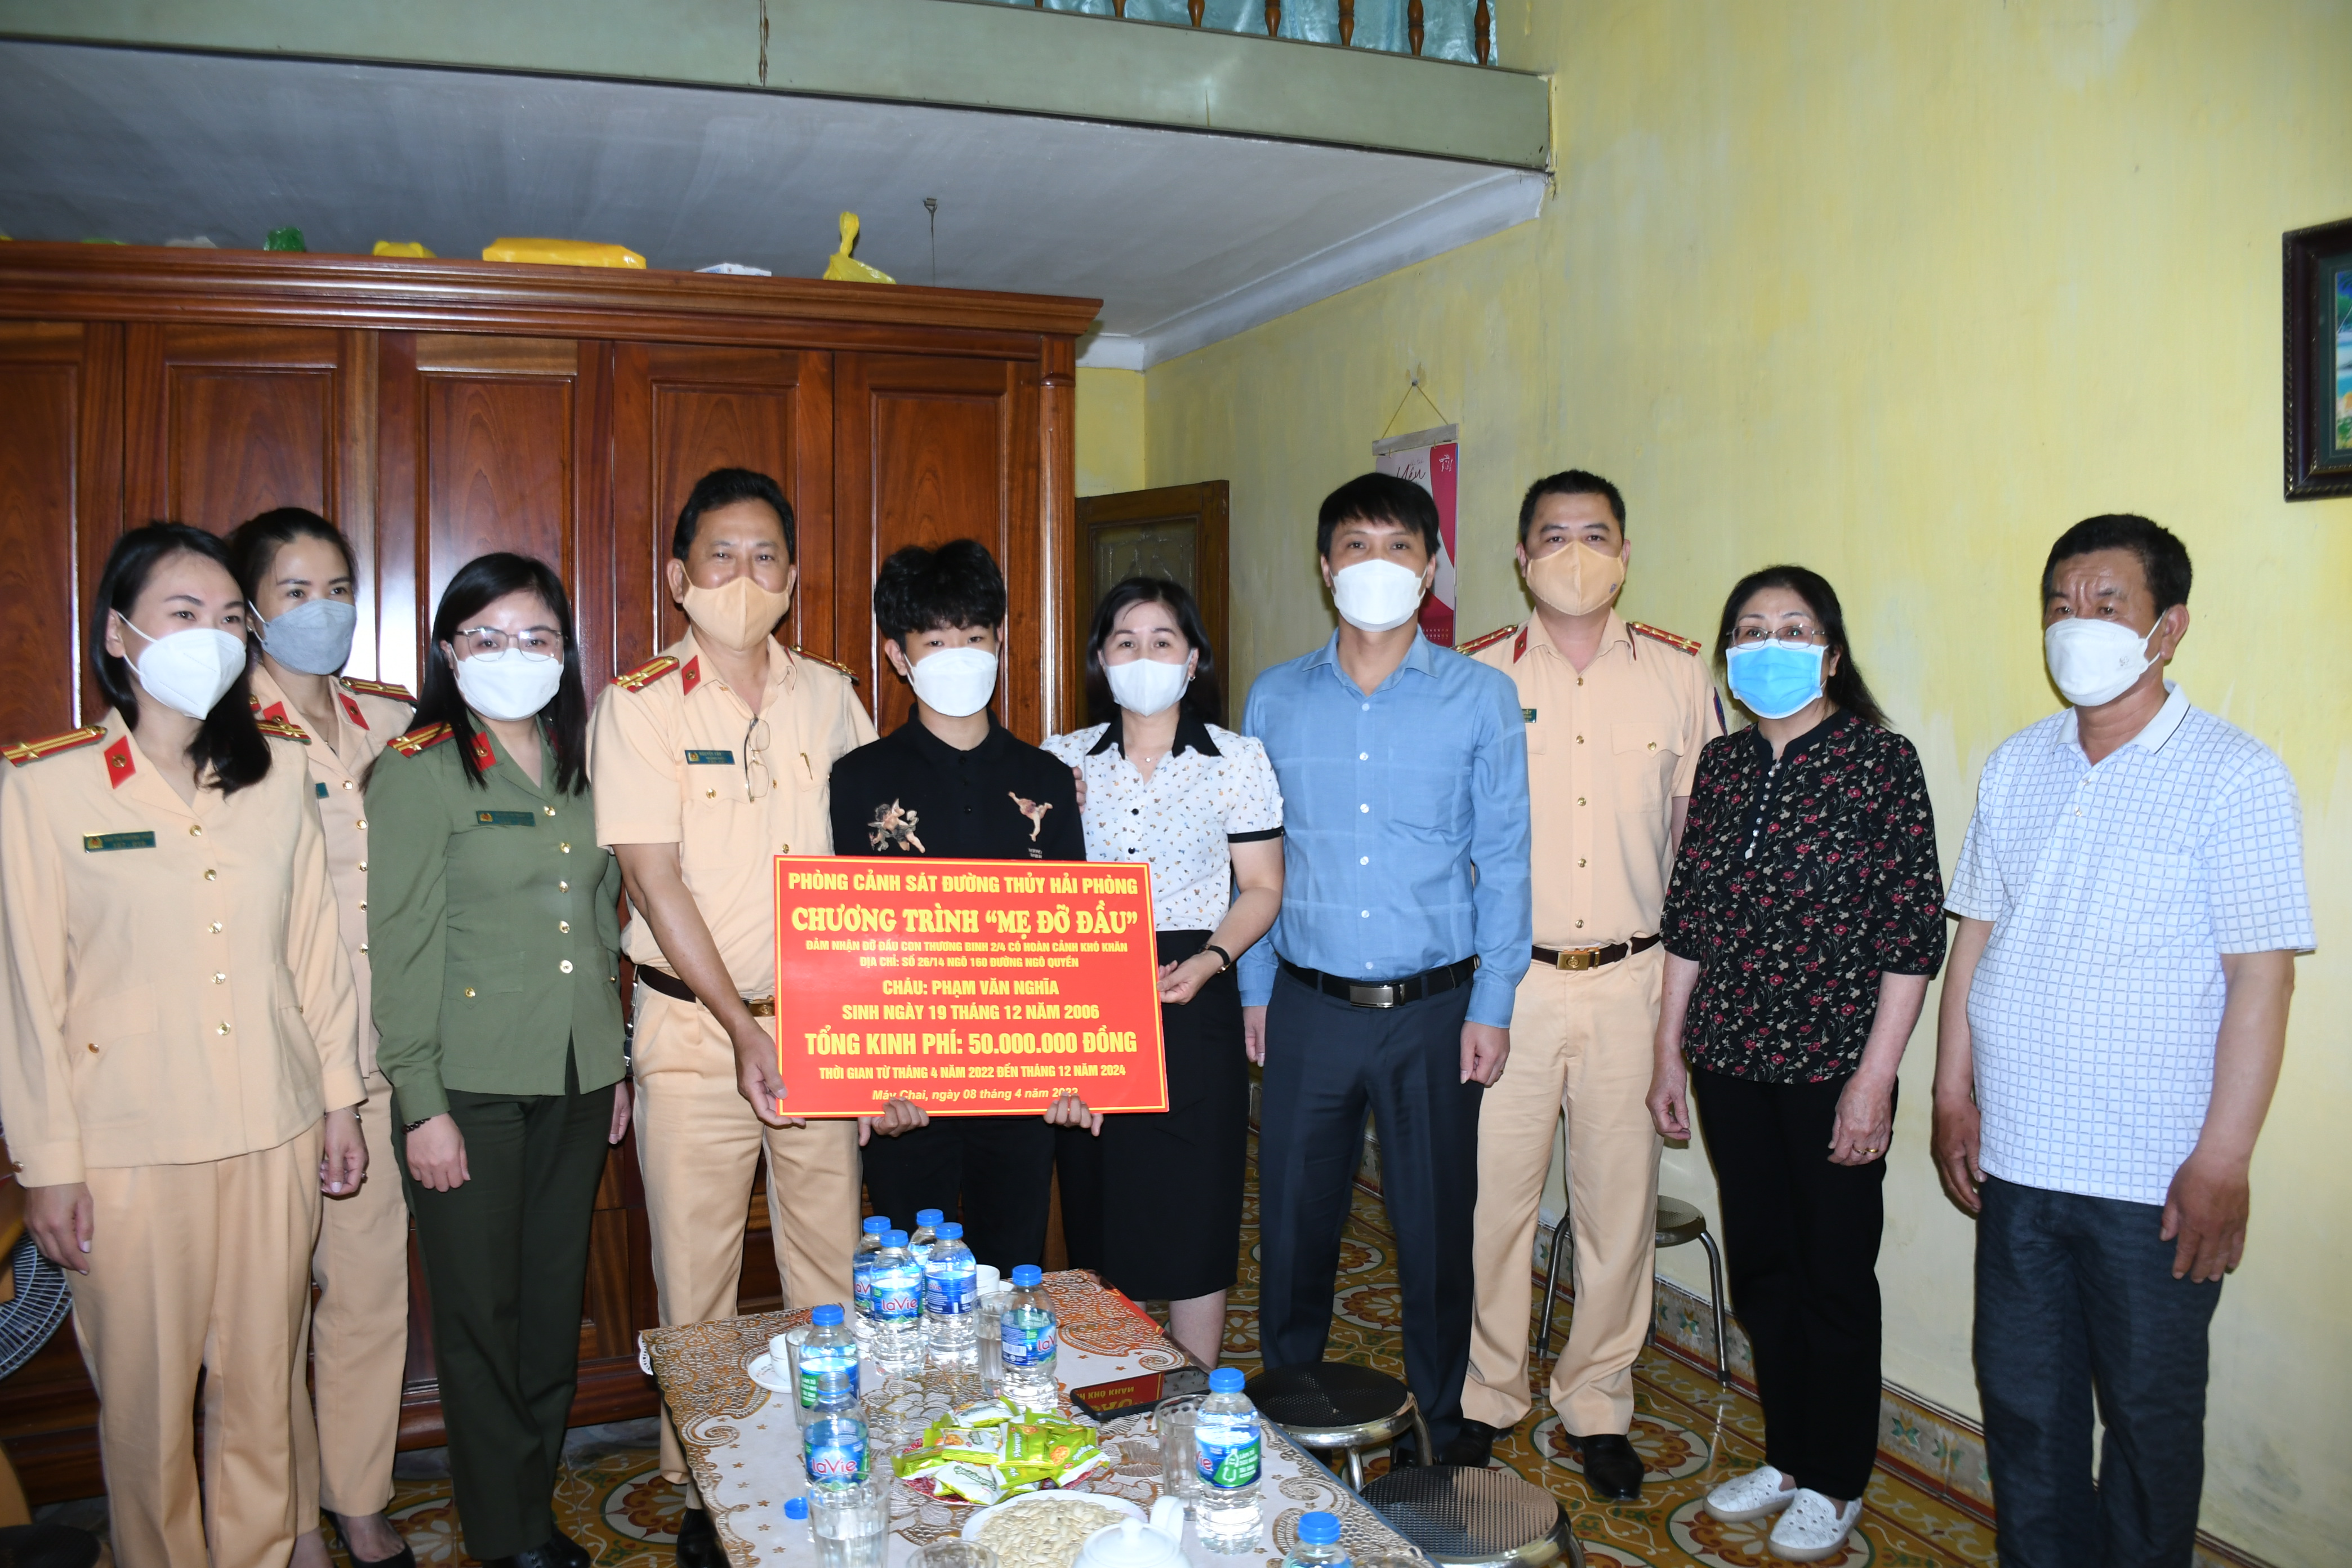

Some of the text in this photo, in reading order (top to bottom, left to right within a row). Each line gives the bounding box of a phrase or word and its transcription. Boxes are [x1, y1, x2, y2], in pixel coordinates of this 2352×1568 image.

[789, 869, 1138, 894] PHÒNG CẢNH SÁT ĐƯỜNG THỦY HẢI PHÒNG
[792, 900, 1137, 939] CHƯƠNG TRÌNH “MẸ ĐỠ ĐẦU”
[806, 938, 1128, 952] ĐẢM NHẬN ĐỠ ĐẦU CON THƯƠNG BINH 2/4 CÓ HOÀN CẢNH KHÓ KHĂN
[860, 954, 1079, 968] ĐỊA CHỈ: SỐ 26/14 NGÕ 160 ĐƯỜNG NGÔ QUYỀN
[883, 977, 1059, 998] CHÁU: PHẠM VĂN NGHĨA
[843, 1002, 1099, 1019] SINH NGÀY 19 THÁNG 12 NĂM 2006
[805, 1025, 1137, 1055] TỔNG KINH PHÍ: 50.000.000 ĐỒNG
[819, 1063, 1126, 1079] THỜI GIAN TỪ THÁNG 4 NĂM 2022 ĐẾN THÁNG 12 NĂM 2024
[899, 1089, 928, 1101] Chai,
[932, 1089, 960, 1102] ngày
[963, 1089, 977, 1099] 08
[980, 1089, 1012, 1101] tháng
[1015, 1089, 1022, 1098] 4
[1024, 1088, 1049, 1098] năm
[881, 1297, 917, 1311] laVie
[812, 1458, 857, 1473] laVie
